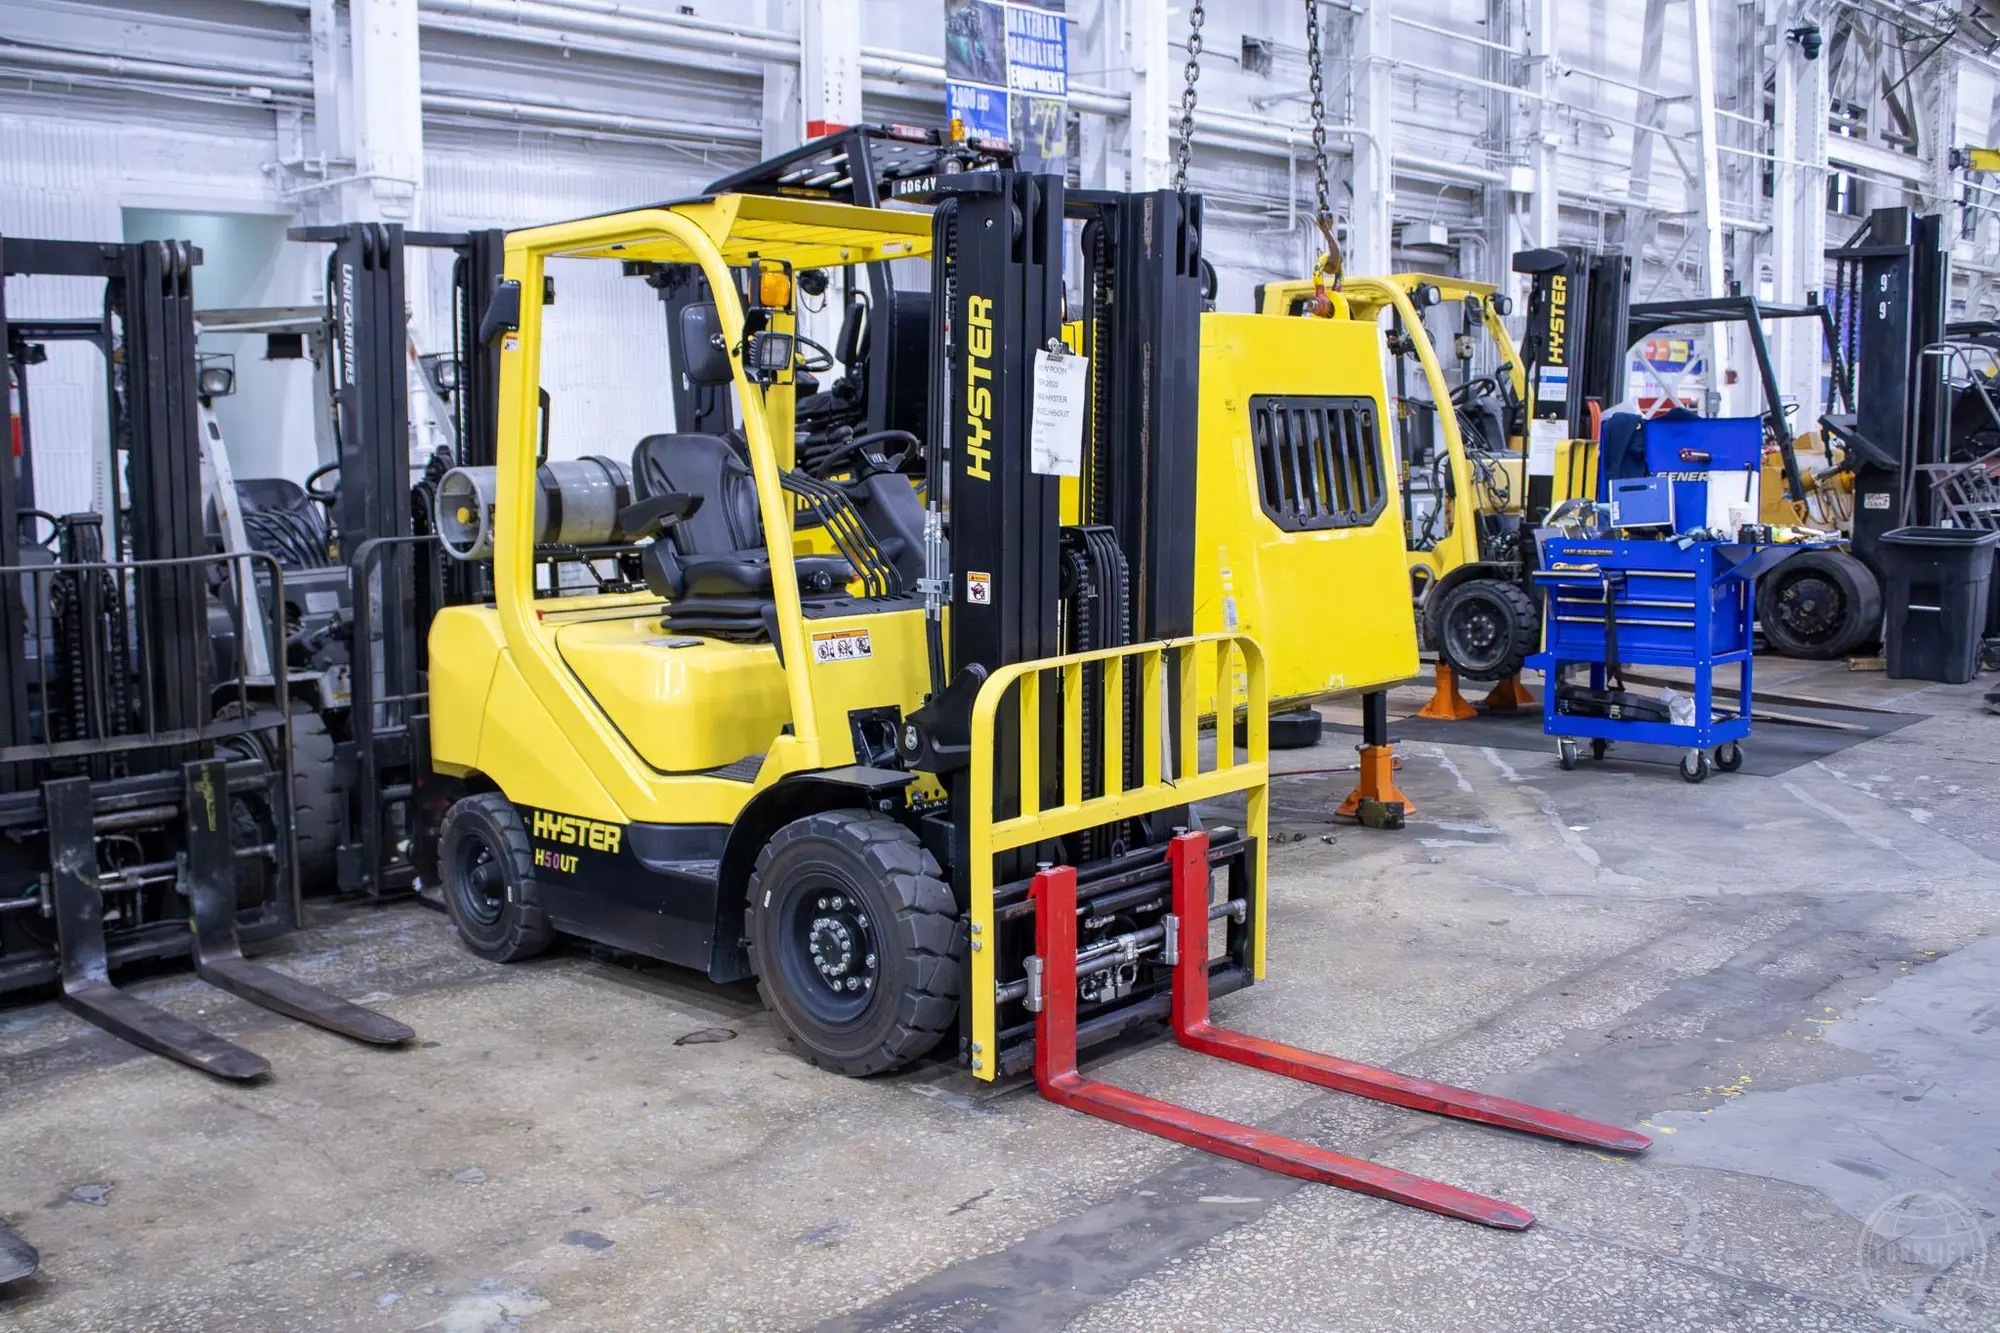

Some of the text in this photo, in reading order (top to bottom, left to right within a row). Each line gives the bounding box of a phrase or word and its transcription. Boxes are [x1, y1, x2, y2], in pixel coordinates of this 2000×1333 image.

[1007, 8, 1062, 42] MATERIAL
[1008, 36, 1065, 69] HANDLING
[1010, 65, 1066, 94] EQUIPMENT
[900, 176, 937, 194] 6064V
[342, 263, 355, 387] UNICARRIERS
[1548, 274, 1568, 365] HYSTER
[967, 294, 993, 482] HYSTER
[1046, 393, 1068, 403] HYSTER
[1656, 471, 1708, 482] GENER
[533, 810, 622, 854] HYSTER
[534, 848, 579, 874] H50UT
